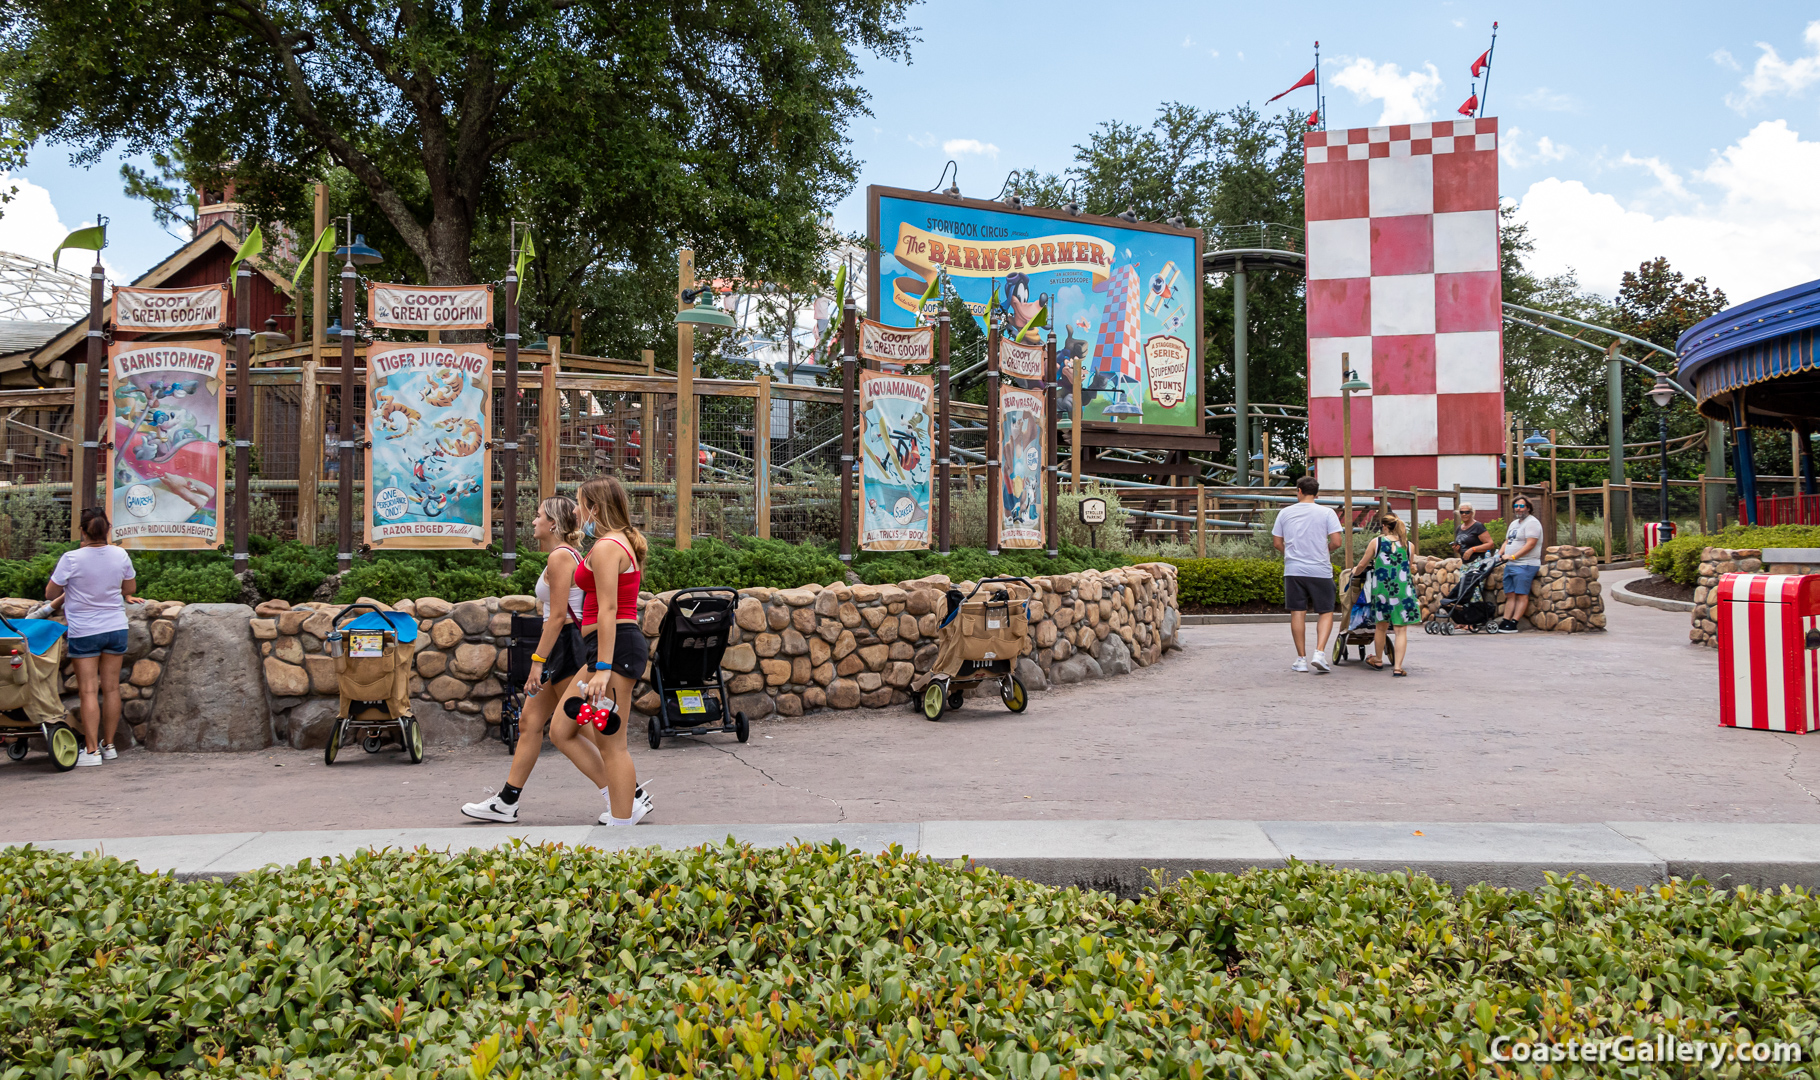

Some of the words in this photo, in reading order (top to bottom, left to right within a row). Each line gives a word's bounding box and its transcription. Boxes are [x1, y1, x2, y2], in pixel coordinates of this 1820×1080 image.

[926, 217, 978, 237] STORYBOOK
[981, 225, 1009, 238] CIRCUS
[902, 235, 926, 256] The
[928, 241, 1106, 271] BARNSTORMER
[144, 296, 193, 308] GOOFY
[404, 294, 458, 306] GOOFY
[379, 309, 390, 318] the
[391, 306, 429, 321] GREAT
[433, 306, 483, 321] GOOFINI
[918, 303, 942, 313] OOF
[132, 308, 167, 323] GREAT
[170, 306, 217, 323] GOOFINI
[881, 332, 913, 344] GOOFY
[873, 340, 896, 355] GREAT
[1012, 349, 1031, 361] GOOFY
[1153, 349, 1180, 359] SERIES
[119, 351, 215, 374] BARNSTORMER
[376, 353, 415, 372] TIGER
[419, 352, 483, 373] JUGGLING
[1150, 363, 1185, 378] STUPENDOUS
[868, 381, 927, 401] AQUAMANIAC
[1153, 380, 1182, 392] STUNTS
[382, 489, 397, 501] ONE
[384, 506, 402, 517] ONLY!
[115, 525, 139, 538] SOARIN'
[148, 524, 186, 534] RIDICULOUS
[187, 526, 215, 537] HEIGHTS
[382, 525, 412, 535] RAZOR
[414, 525, 443, 534] EDGED
[445, 524, 473, 535] Thrills!
